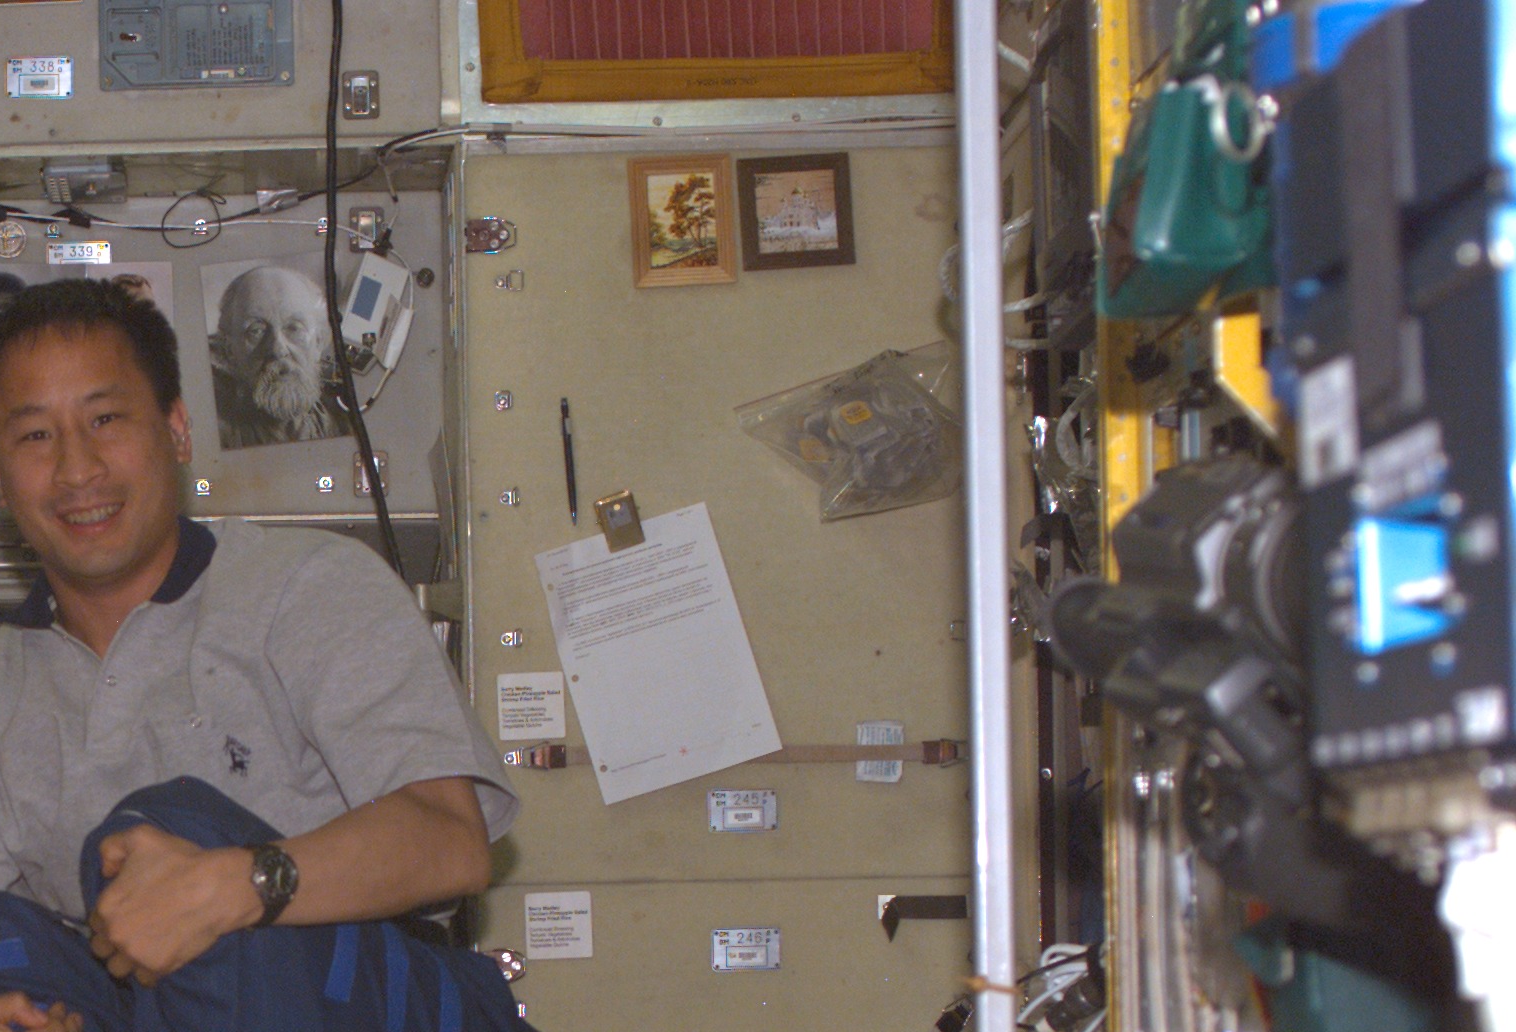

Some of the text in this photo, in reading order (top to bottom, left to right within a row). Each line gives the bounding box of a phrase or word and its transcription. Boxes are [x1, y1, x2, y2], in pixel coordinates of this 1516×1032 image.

[29, 60, 55, 73] 338
[69, 245, 94, 258] 339
[733, 792, 759, 806] 245
[736, 931, 763, 944] 246
